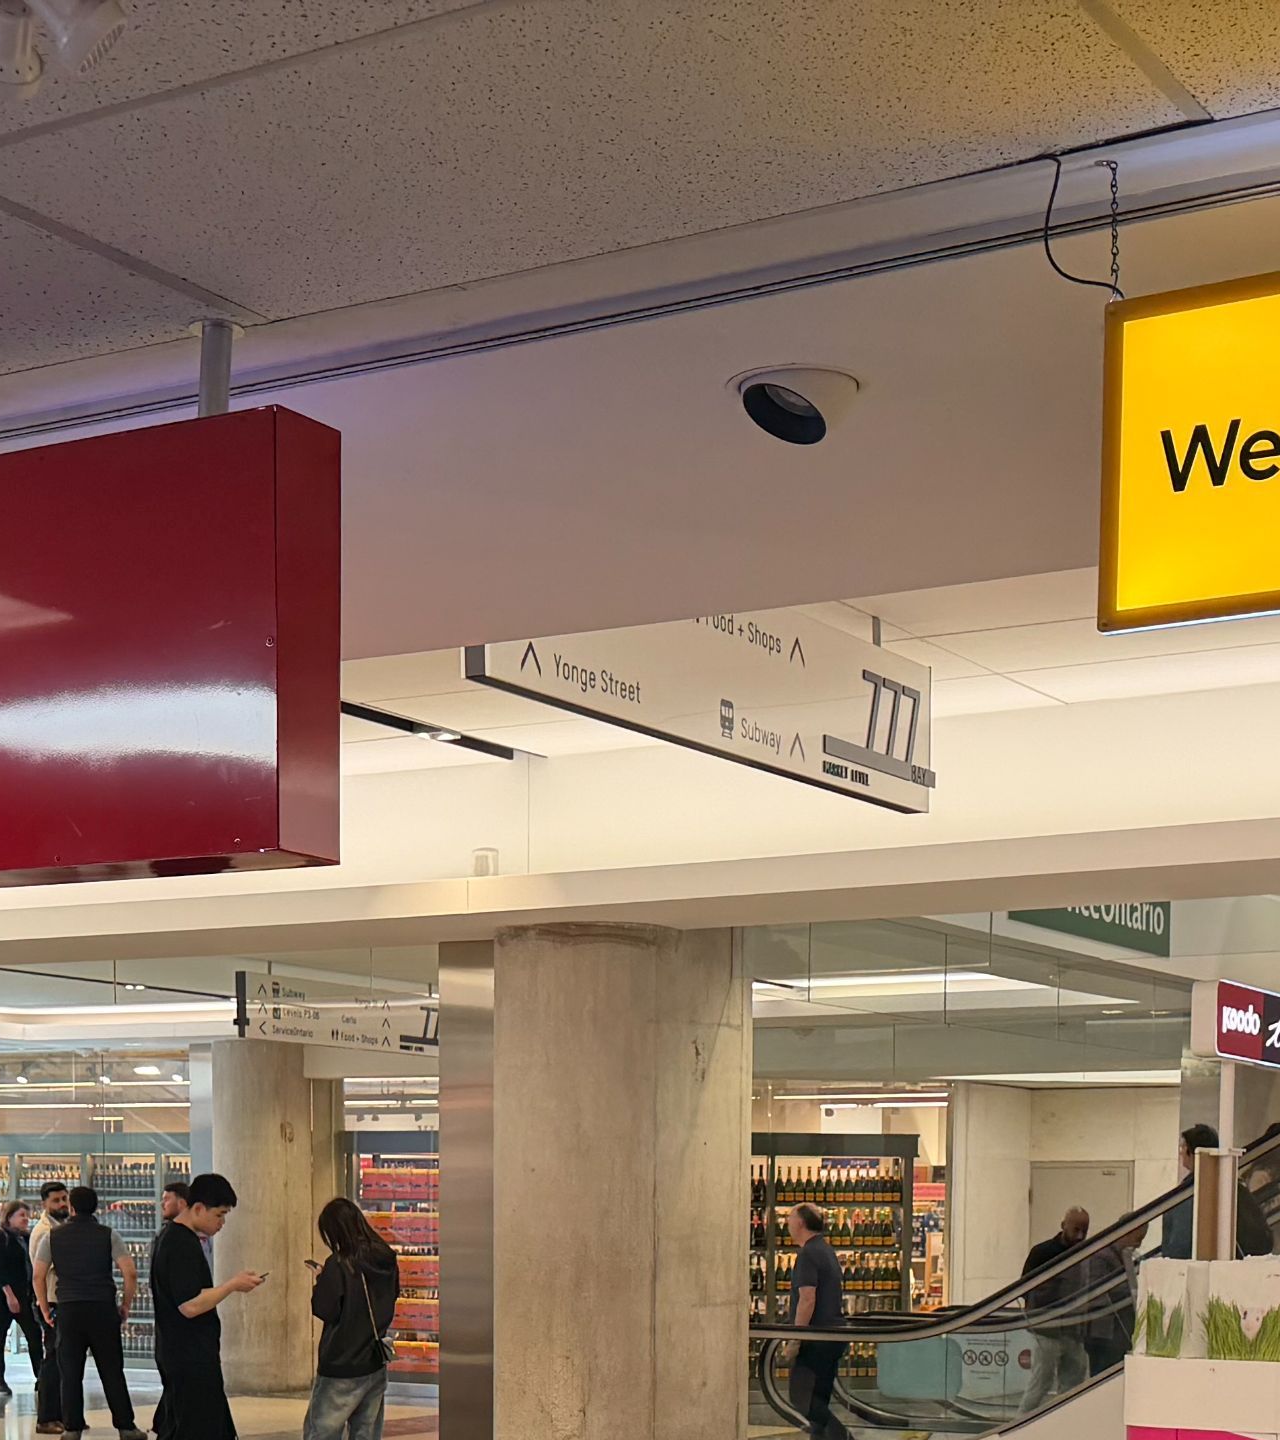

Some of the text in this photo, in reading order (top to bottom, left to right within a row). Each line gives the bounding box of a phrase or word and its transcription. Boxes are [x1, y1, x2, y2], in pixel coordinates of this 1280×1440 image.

[748, 621, 782, 655] Shops
[553, 652, 641, 704] Yonge Street
[862, 669, 921, 764] 777
[741, 717, 782, 755] Subway
[911, 764, 927, 788] BAY
[272, 1024, 314, 1039] ServiceOntario
[1221, 1004, 1261, 1036] koodo
[360, 1033, 379, 1046] Shops
